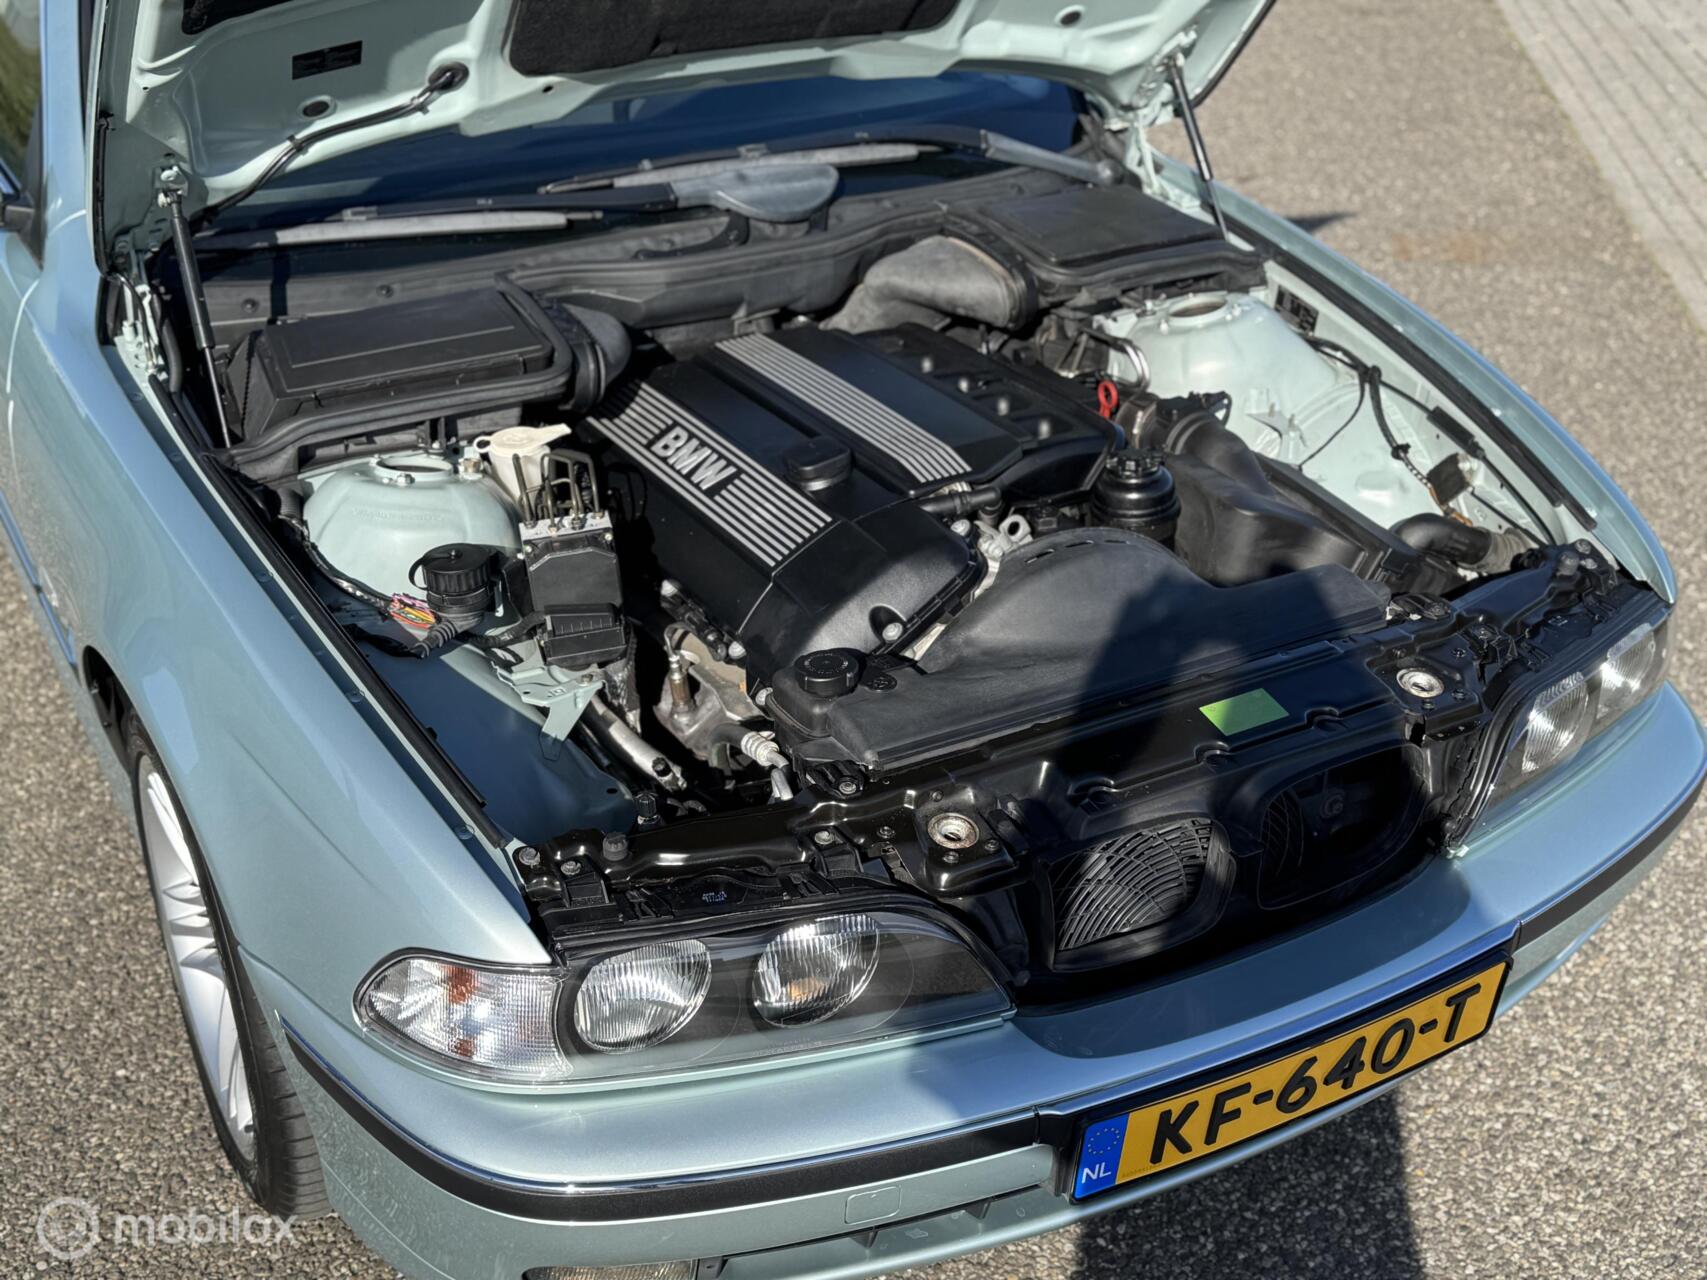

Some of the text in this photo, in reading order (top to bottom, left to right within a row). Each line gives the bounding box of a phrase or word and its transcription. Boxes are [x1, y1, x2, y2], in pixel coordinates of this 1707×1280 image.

[651, 426, 738, 490] BMW
[1150, 982, 1482, 1165] KF-640-T
[1081, 1162, 1112, 1184] NL
